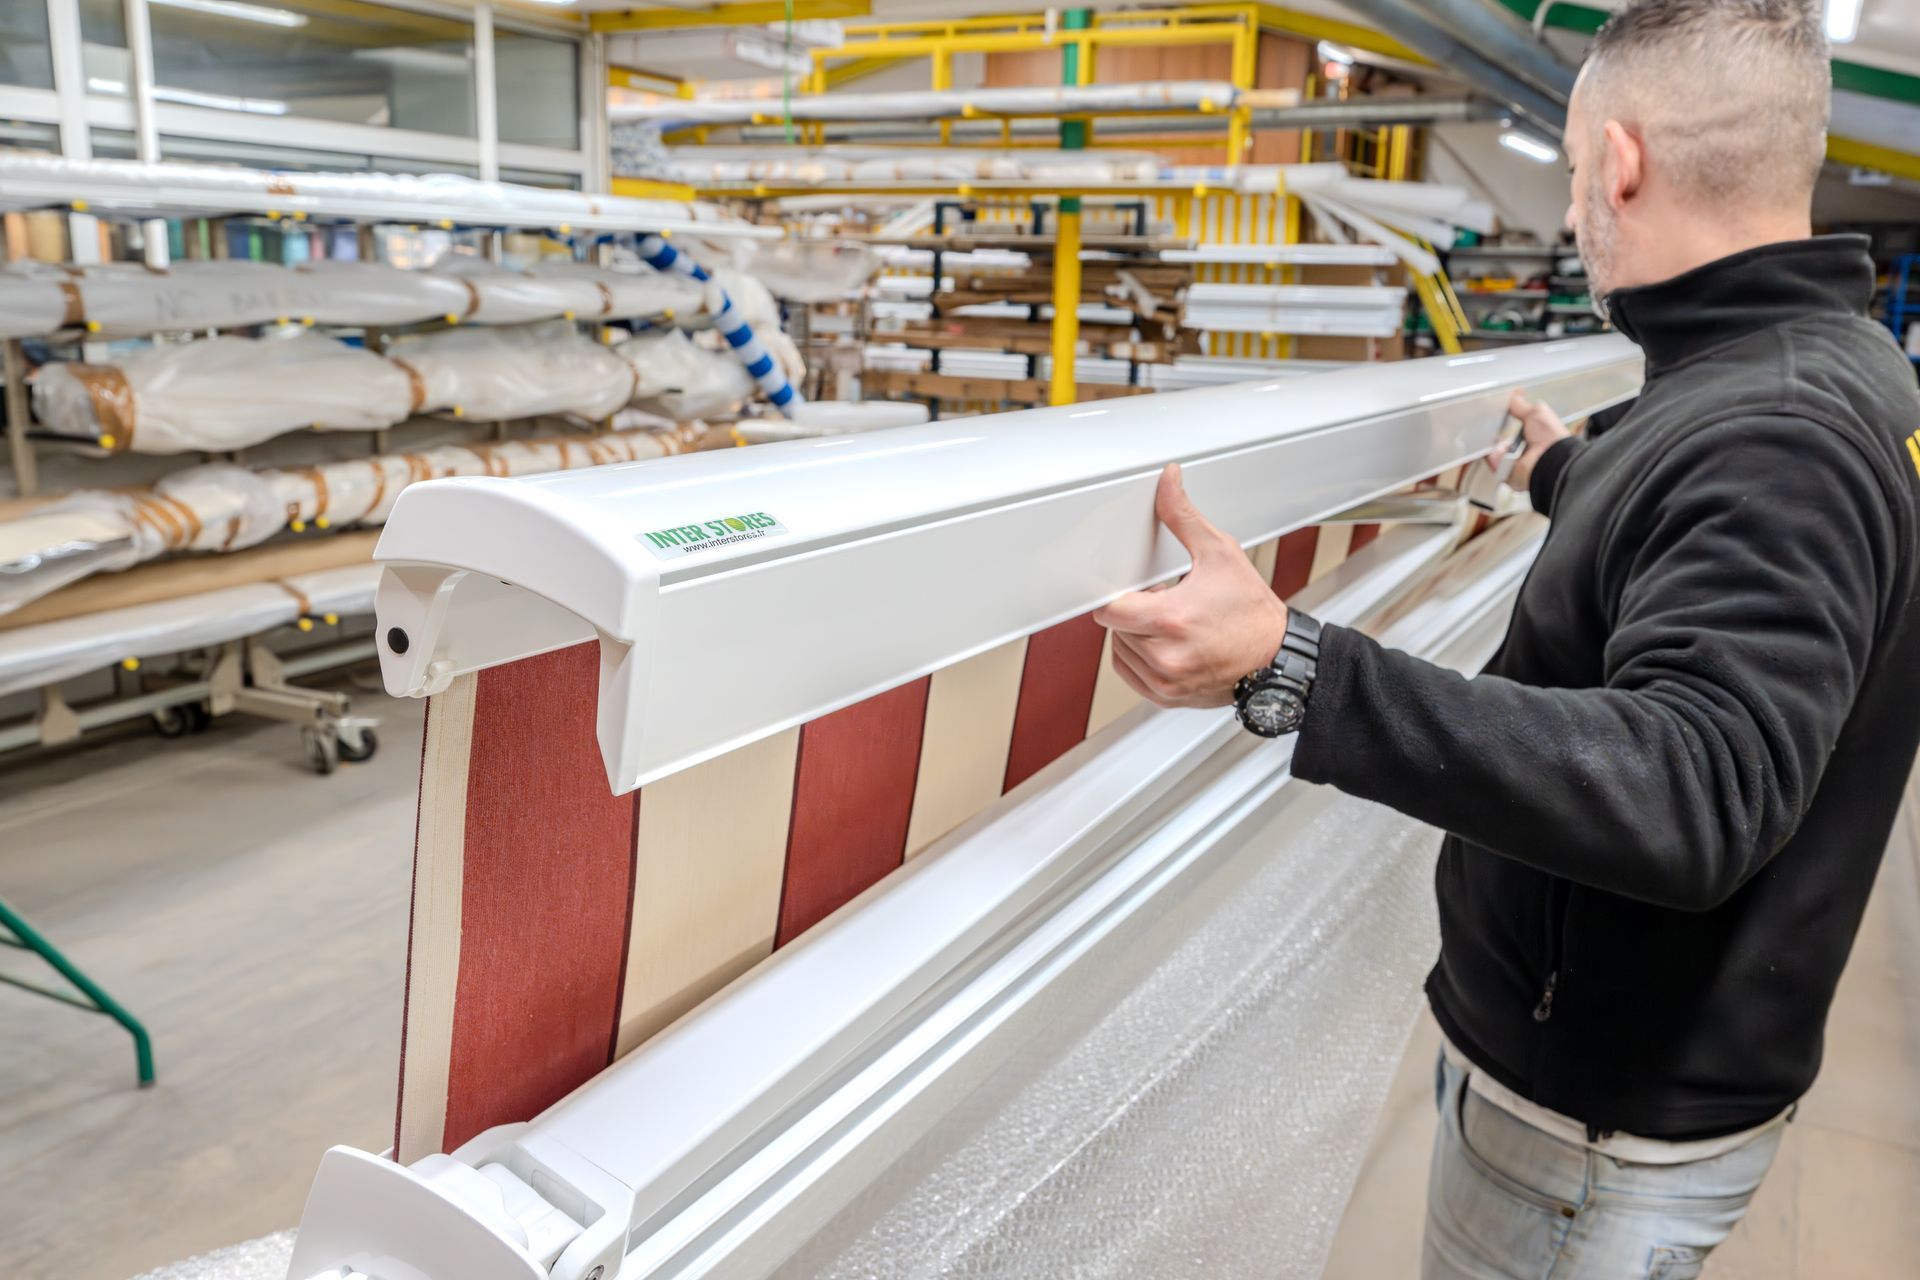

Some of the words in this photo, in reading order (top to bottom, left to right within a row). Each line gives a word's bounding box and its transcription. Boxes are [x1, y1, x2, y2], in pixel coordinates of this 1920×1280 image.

[644, 524, 711, 549] INTER
[704, 511, 776, 538] STORES
[683, 529, 765, 553] www.interstores.fr
